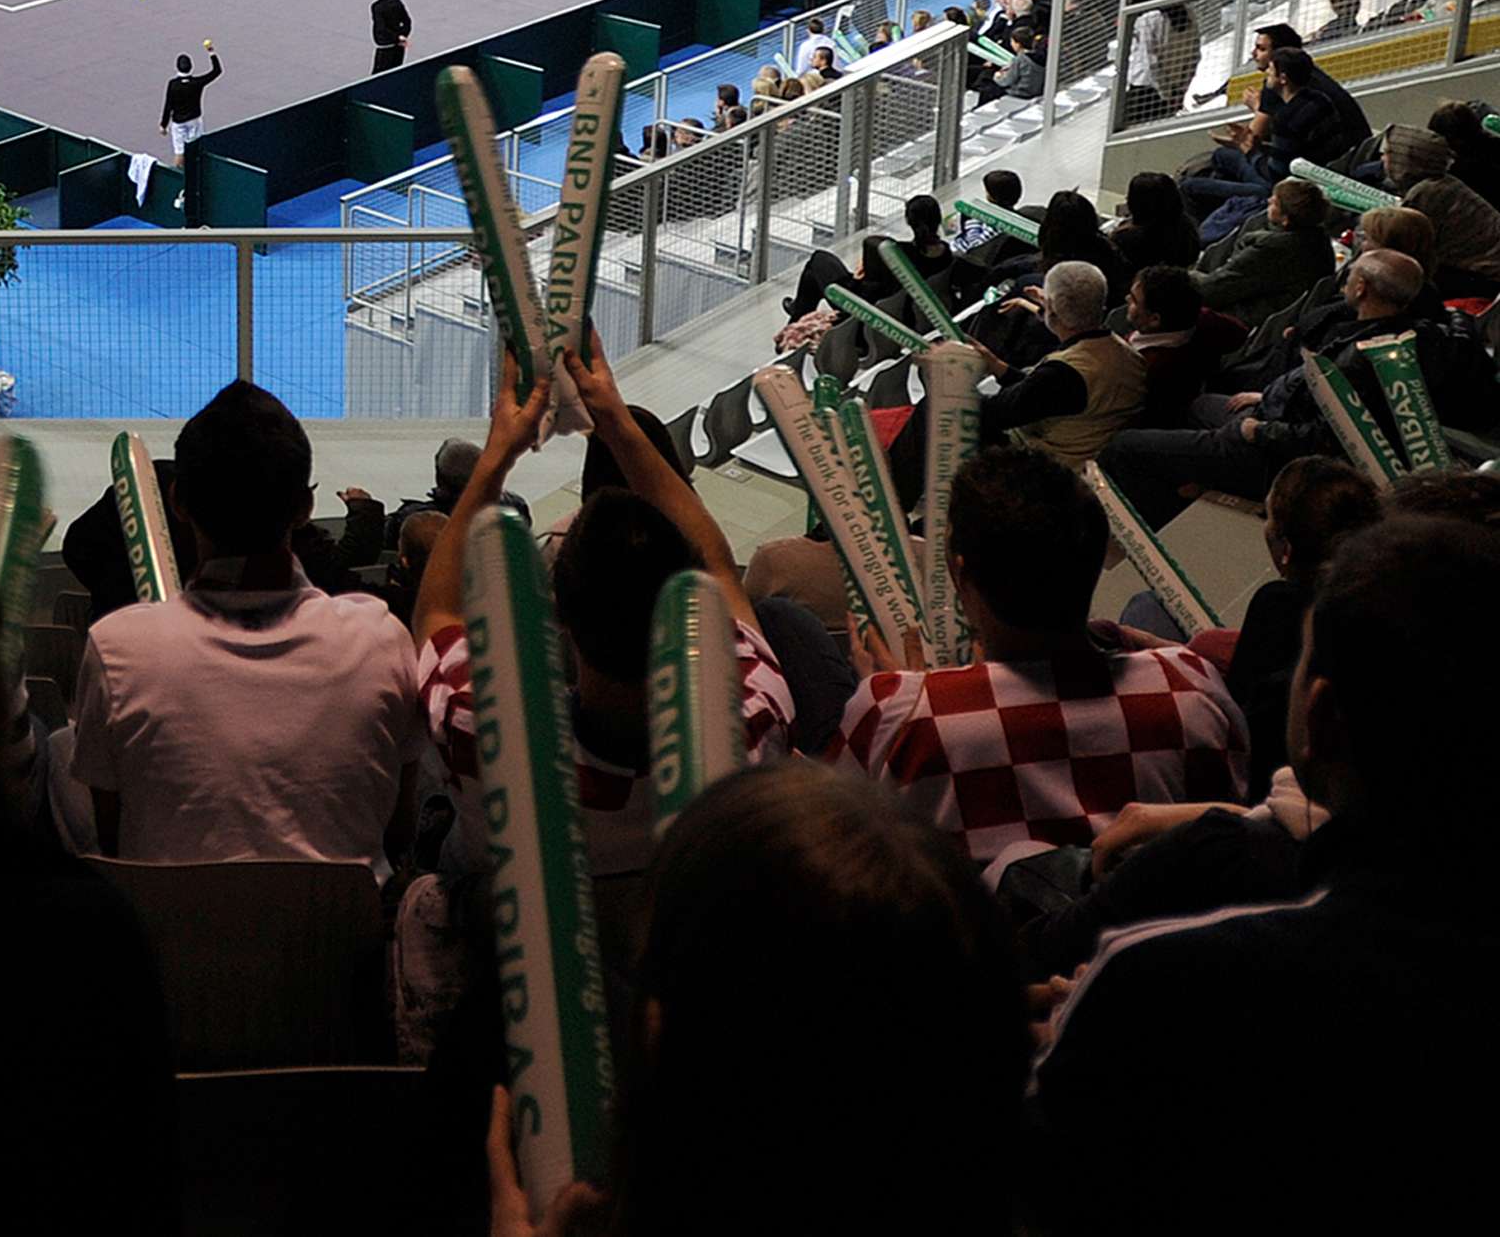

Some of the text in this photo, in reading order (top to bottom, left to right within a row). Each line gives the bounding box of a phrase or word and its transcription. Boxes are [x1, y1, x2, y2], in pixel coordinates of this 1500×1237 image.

[573, 113, 599, 191] BNP
[937, 410, 952, 437] The
[937, 442, 953, 482] bank
[794, 414, 814, 445] The
[808, 445, 836, 484] bank
[824, 483, 850, 507] for
[849, 522, 892, 597] changing
[931, 533, 948, 610] changing
